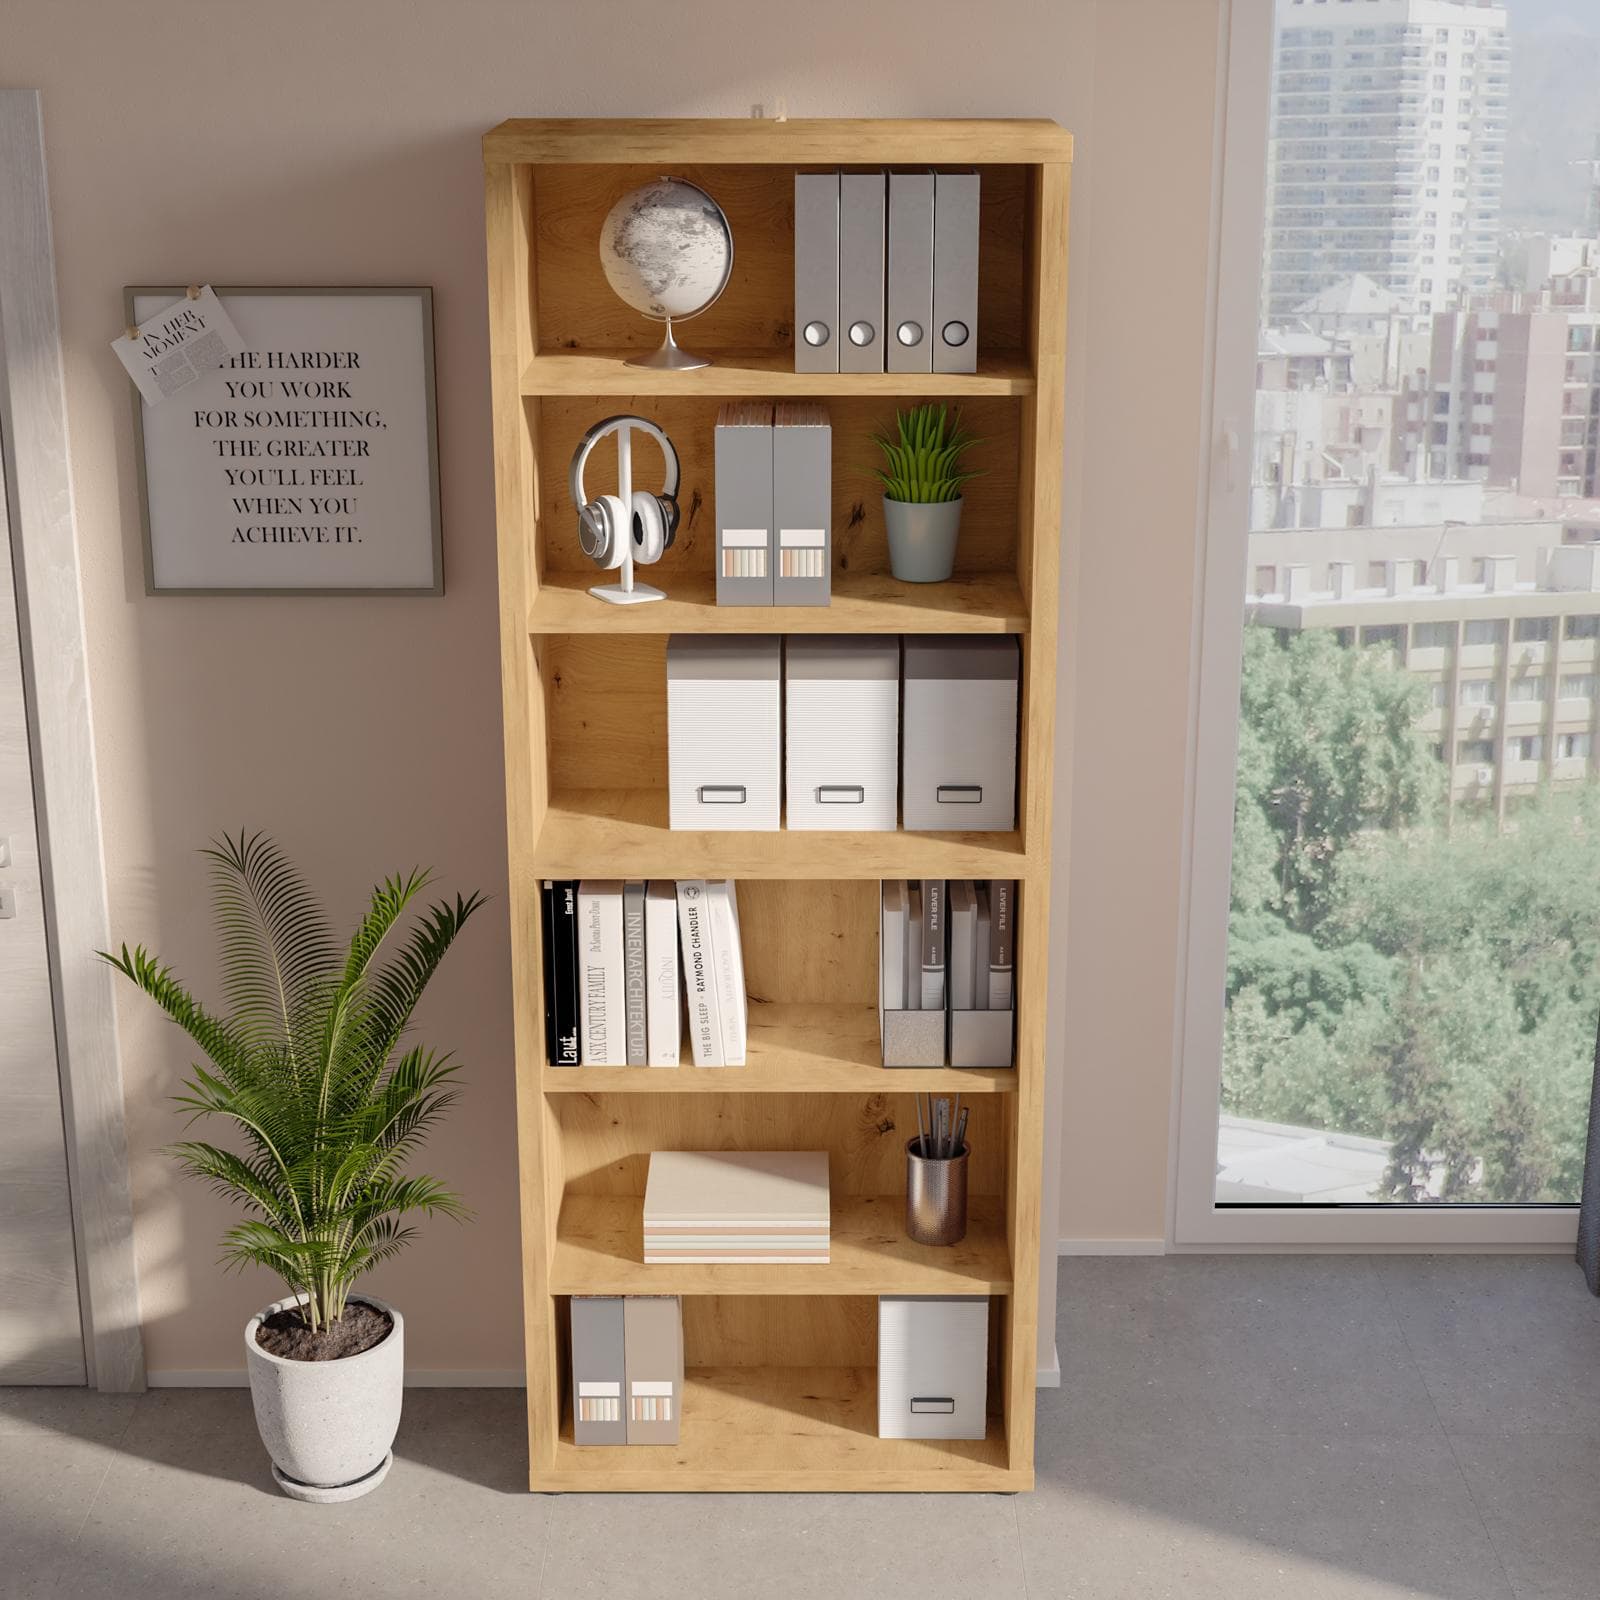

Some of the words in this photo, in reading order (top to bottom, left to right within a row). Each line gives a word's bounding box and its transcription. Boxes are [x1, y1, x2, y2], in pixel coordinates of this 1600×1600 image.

[219, 352, 262, 368] HE
[267, 352, 360, 368] HARDER
[225, 381, 273, 398] YOU
[280, 381, 352, 398] WORK
[194, 411, 238, 428] FOR
[243, 411, 387, 430] SOMETHING,
[213, 440, 262, 457] THE
[266, 440, 370, 457] GREATER
[224, 469, 305, 486] YOU'LL
[310, 469, 364, 486] FEEL
[232, 498, 302, 515] WHEN
[309, 498, 358, 515] YOU
[232, 526, 329, 543] ACHIEVE
[335, 526, 363, 543] IT.
[688, 906, 701, 949] CHANDLER
[693, 951, 706, 993] RAYMOND
[587, 965, 606, 998] FAMILY
[627, 912, 644, 1057] INNENARCHITEKTUR
[589, 999, 607, 1041] CENTURY
[698, 1002, 709, 1025] SLEEP
[701, 1026, 711, 1041] BIG
[704, 1042, 712, 1058] THE
